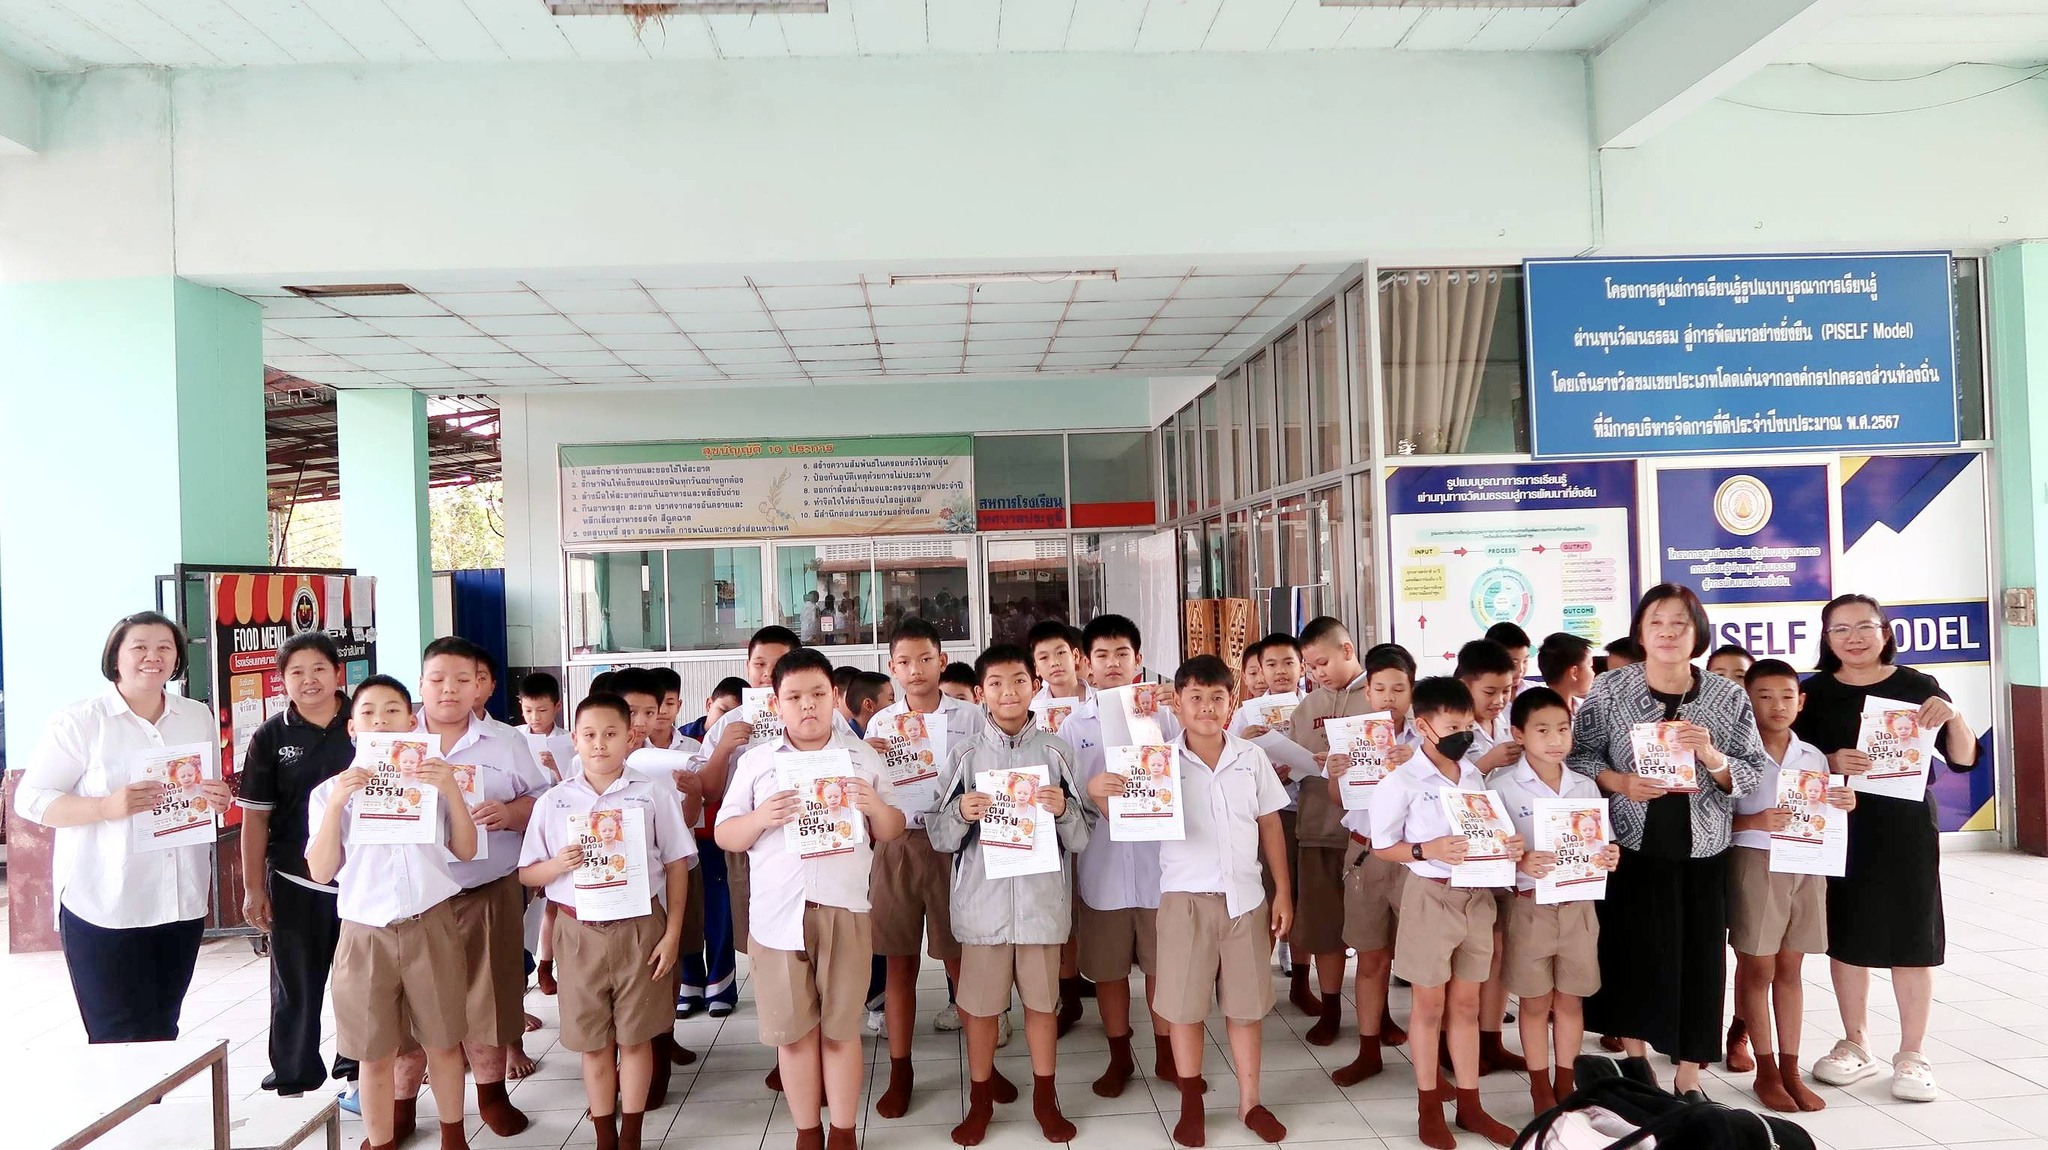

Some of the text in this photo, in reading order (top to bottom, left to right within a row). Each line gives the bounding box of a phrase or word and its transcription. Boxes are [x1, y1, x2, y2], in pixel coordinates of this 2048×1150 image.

[1605, 272, 1877, 306] โครงการศูนย์การเรียนรู้รูปแบบบูรณาการเรียนรู้
[1574, 316, 1914, 355] ผ่านทุนวัฒนธรรม สู่การพัฒนาอย่างยั่งยืน (PISELF Model)
[1593, 409, 1900, 438] ที่มีการบริหารจัดการที่ดีประจำปีงบประมาณ พ.ศ.2567
[702, 444, 835, 460] สุขบัญญัติ 10 ประการ
[1446, 473, 1568, 490] รูปแบบบูรณาการการเรียนรู้
[233, 627, 259, 652] FOOD
[1710, 621, 1807, 655] ISELF
[1891, 616, 1981, 653] ODEL
[759, 710, 773, 718] ปิด
[753, 728, 783, 738] ธรรม
[1875, 730, 1892, 740] ปิด
[889, 735, 905, 745] ปิด
[1356, 737, 1370, 747] ปิด
[1646, 742, 1663, 753] ปิด
[885, 748, 903, 759] เติม
[1869, 750, 1903, 761] ธรรม
[886, 752, 918, 767] ธรรม
[1350, 758, 1381, 767] ธรรม
[378, 761, 396, 773] ปิด
[1130, 765, 1146, 776] ปิด
[1640, 765, 1676, 775] ธรรม
[370, 775, 389, 786] ติม
[1125, 778, 1141, 789] ติม
[365, 786, 404, 797] ธรรม
[995, 790, 1011, 802] ปิด
[1122, 789, 1156, 799] ธรรม
[1788, 789, 1803, 800] ปิด
[806, 800, 823, 811] ปิด
[1461, 809, 1477, 819] ปิด
[798, 814, 819, 826] เติม
[984, 814, 1018, 826] ธรรม
[799, 822, 835, 836] ธรรม
[1463, 829, 1494, 839] ธรรม
[580, 834, 597, 844] ปิด
[1561, 833, 1578, 843] ปิด
[583, 856, 608, 868] รรม
[1556, 855, 1589, 866] ธรรม
